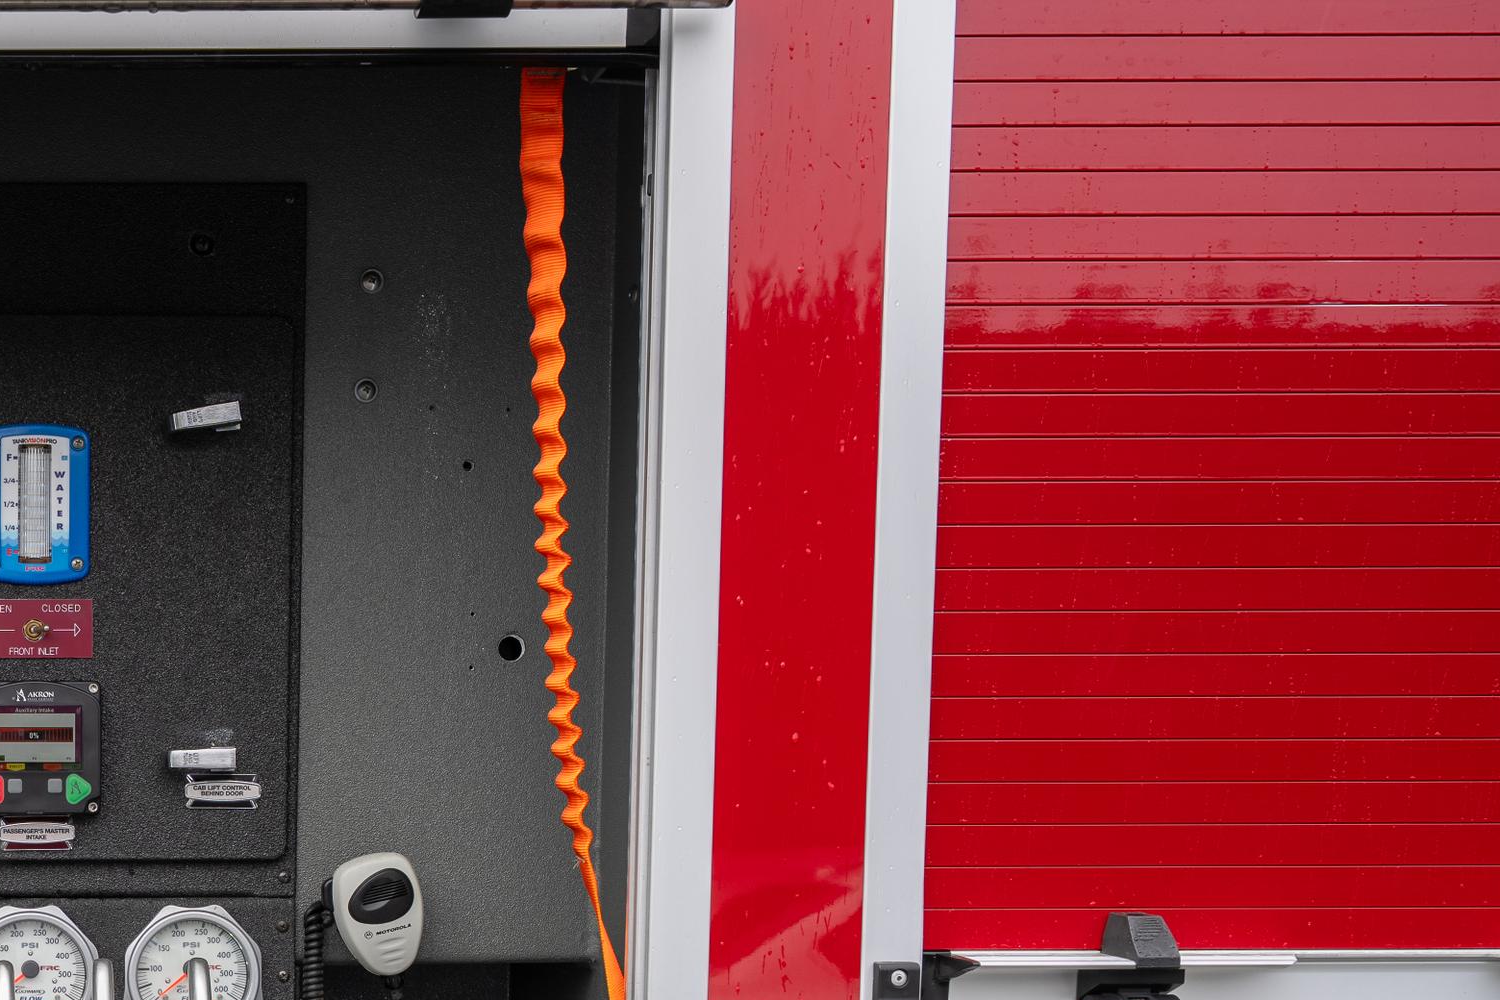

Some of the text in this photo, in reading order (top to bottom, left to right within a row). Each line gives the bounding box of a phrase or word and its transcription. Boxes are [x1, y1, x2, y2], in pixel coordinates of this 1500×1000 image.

[54, 471, 65, 530] WATER
[42, 604, 81, 613] CLOSED
[9, 647, 59, 655] FRONT INLET
[376, 923, 412, 935] MOTOROLA
[45, 937, 59, 945] 300
